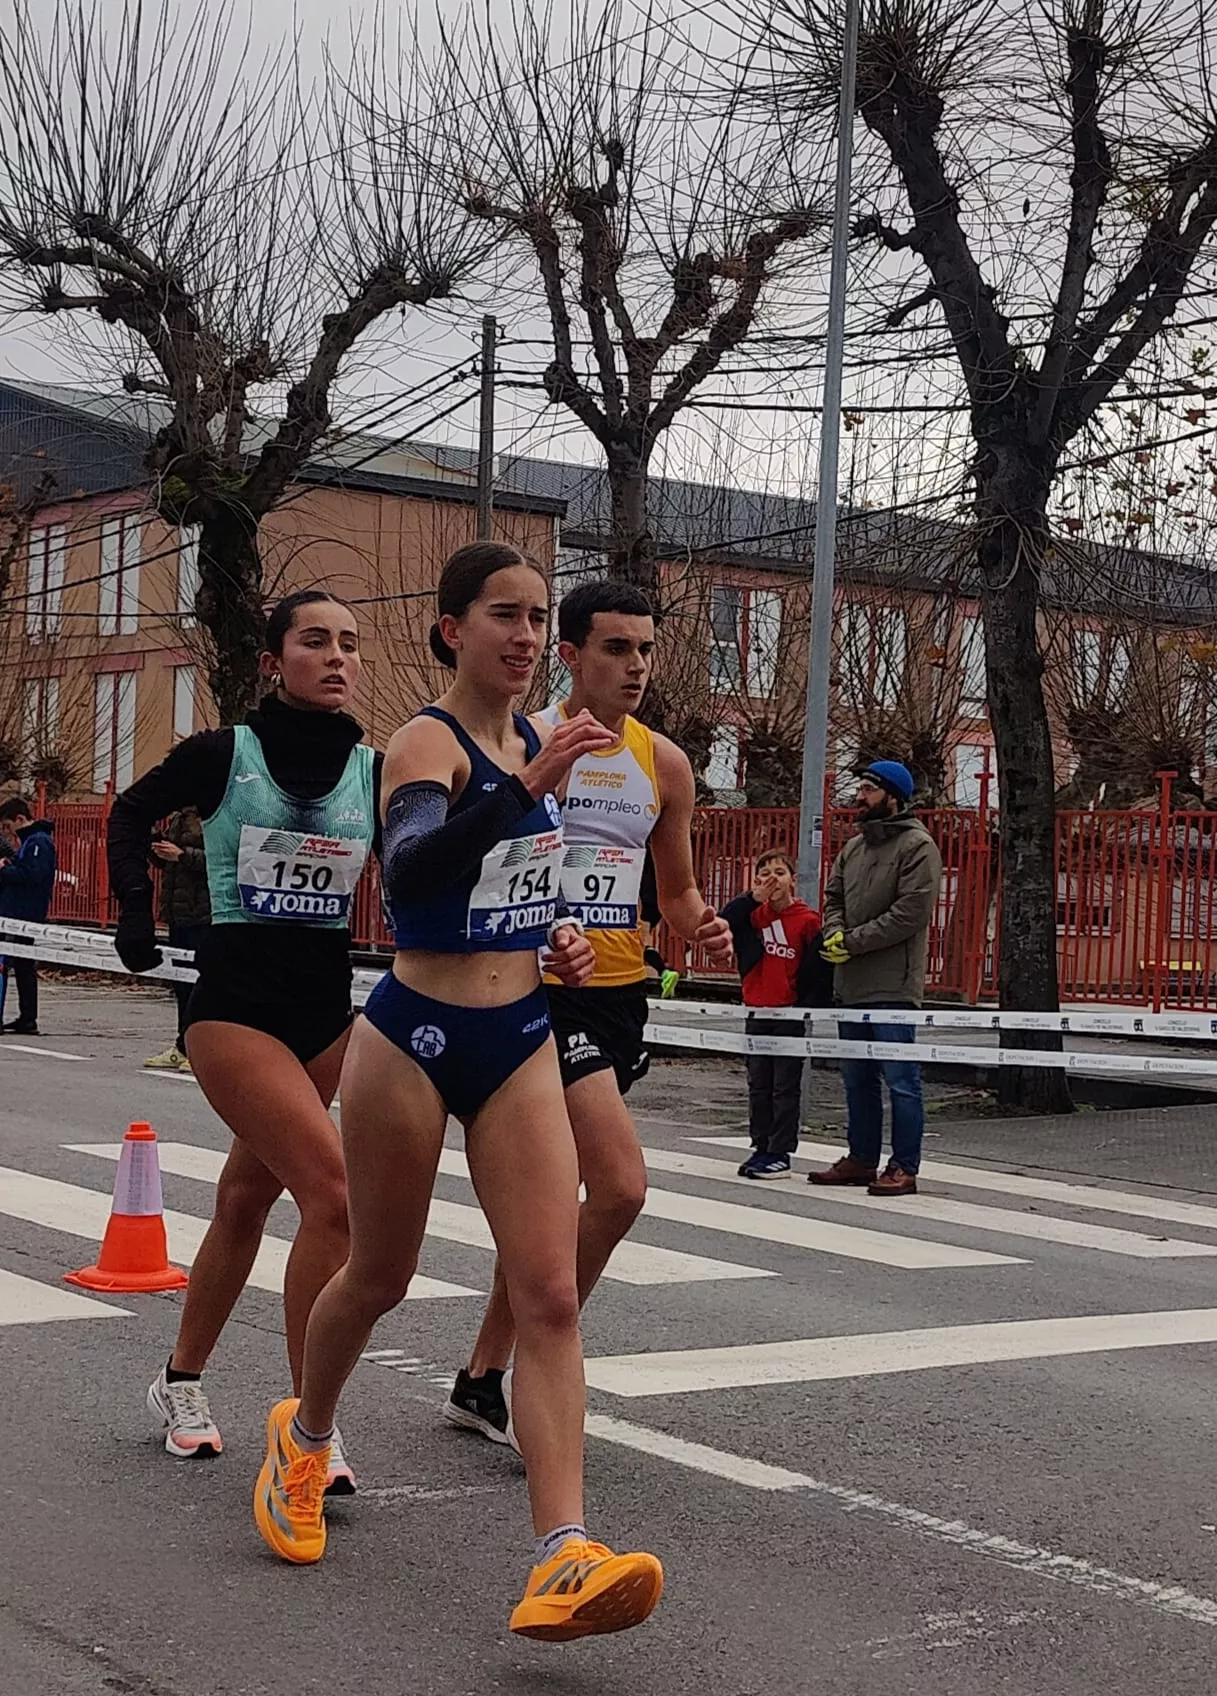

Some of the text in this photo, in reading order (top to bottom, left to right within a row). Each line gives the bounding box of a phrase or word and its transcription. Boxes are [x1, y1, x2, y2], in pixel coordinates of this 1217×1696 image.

[576, 769, 627, 781] PAMPLONA
[567, 796, 641, 815] pompleo
[272, 861, 333, 891] 150
[508, 866, 551, 904] 154
[584, 874, 616, 902] 97
[567, 1031, 590, 1049] PA
